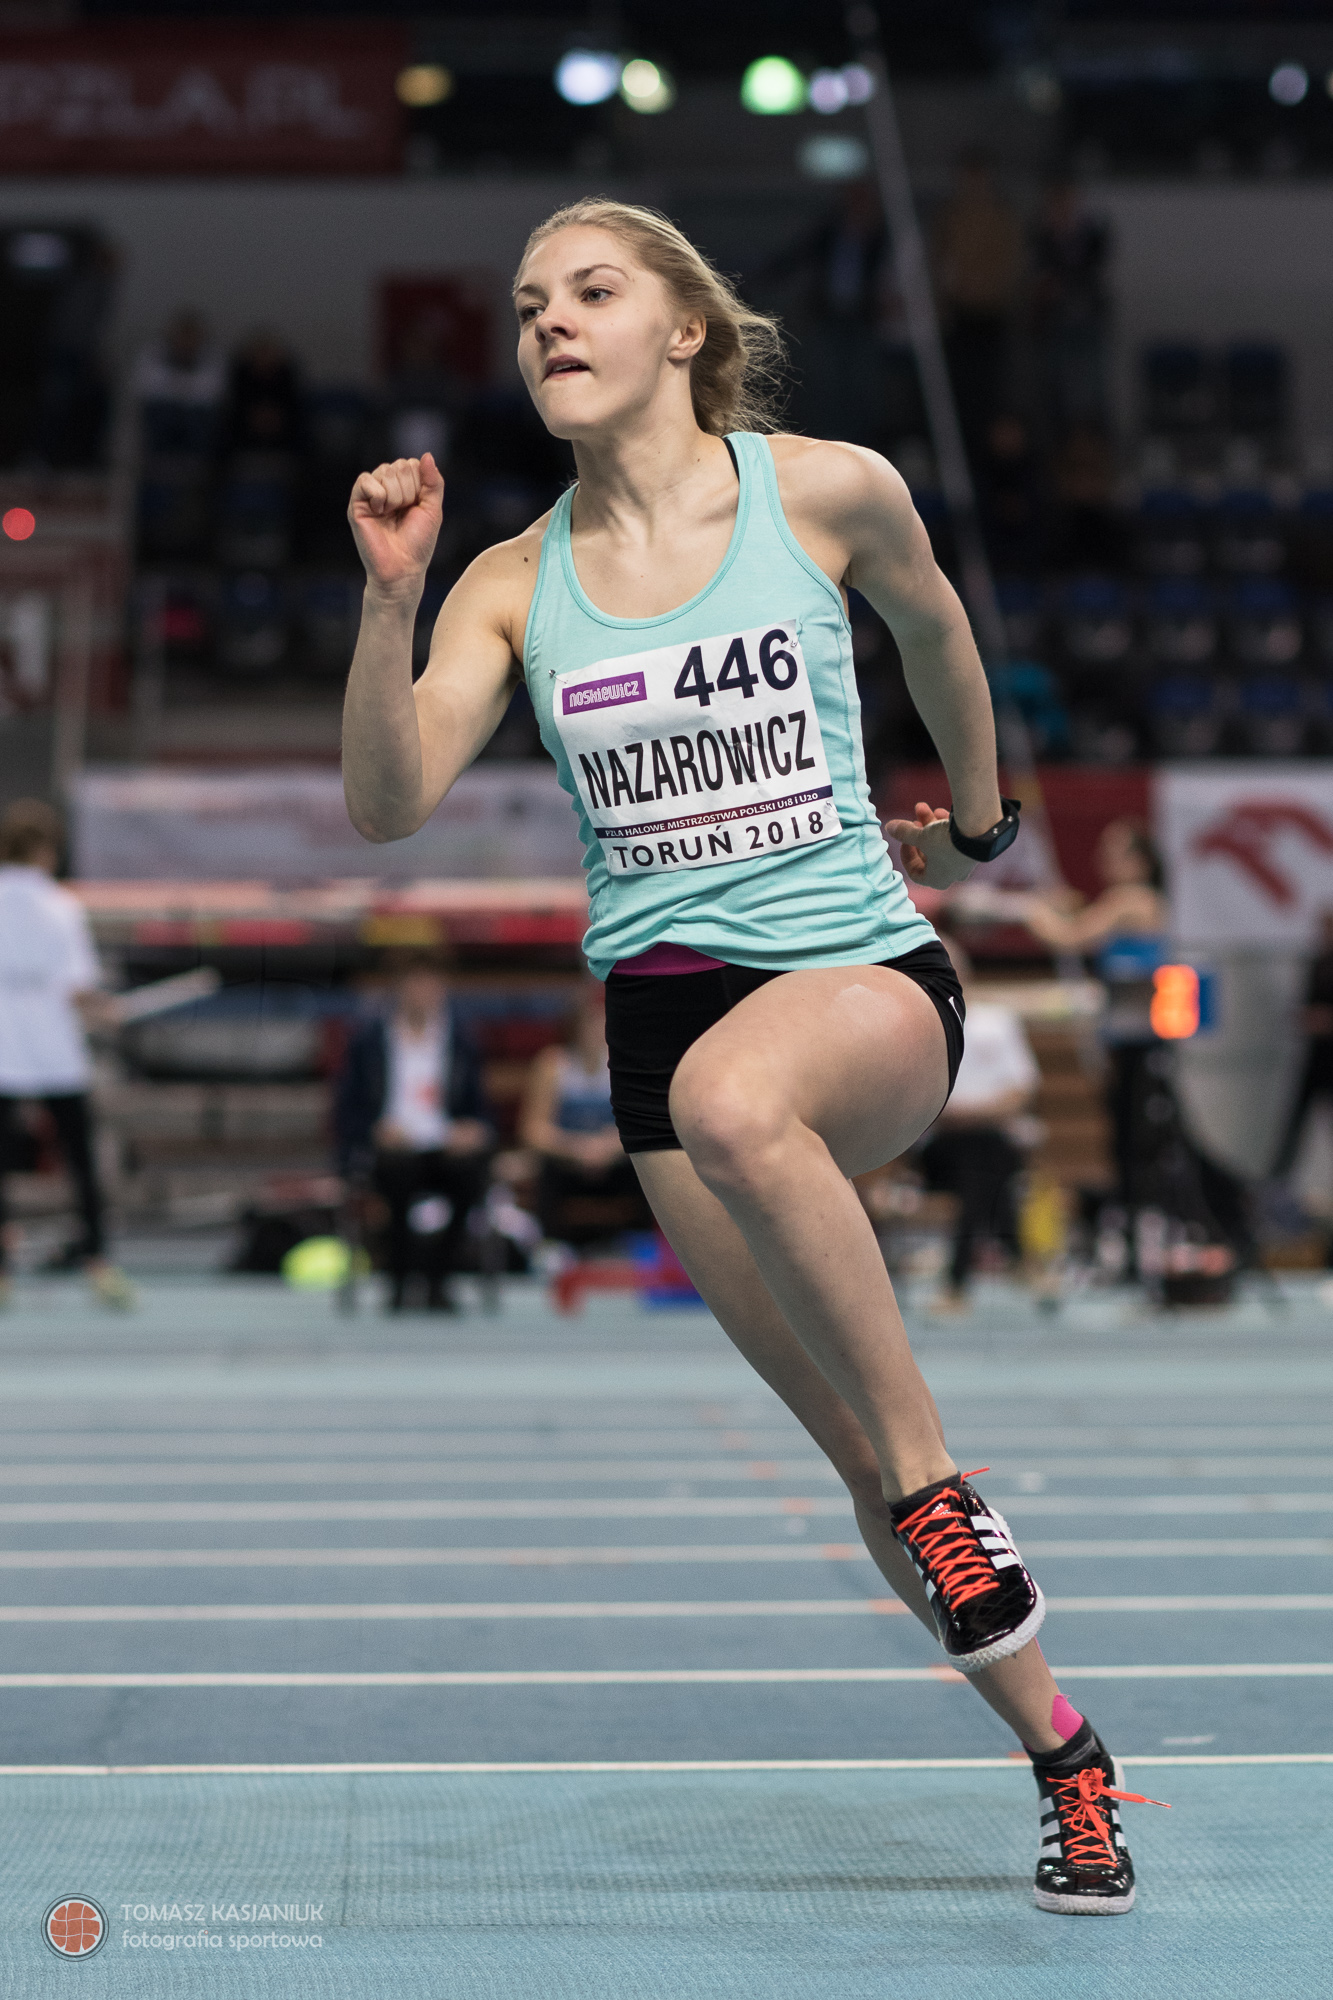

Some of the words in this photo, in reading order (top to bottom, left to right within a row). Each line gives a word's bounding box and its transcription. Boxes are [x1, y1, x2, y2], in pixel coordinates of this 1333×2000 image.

[673, 628, 799, 708] 446
[577, 709, 816, 810] NAZAROWICZ
[612, 824, 734, 869] TORUŃ
[745, 810, 824, 850] 2018
[625, 823, 666, 837] HALOWE
[667, 811, 739, 830] MISTRZOSTWA
[739, 803, 776, 817] POLSKI
[777, 797, 794, 809] U18
[799, 792, 819, 803] U20
